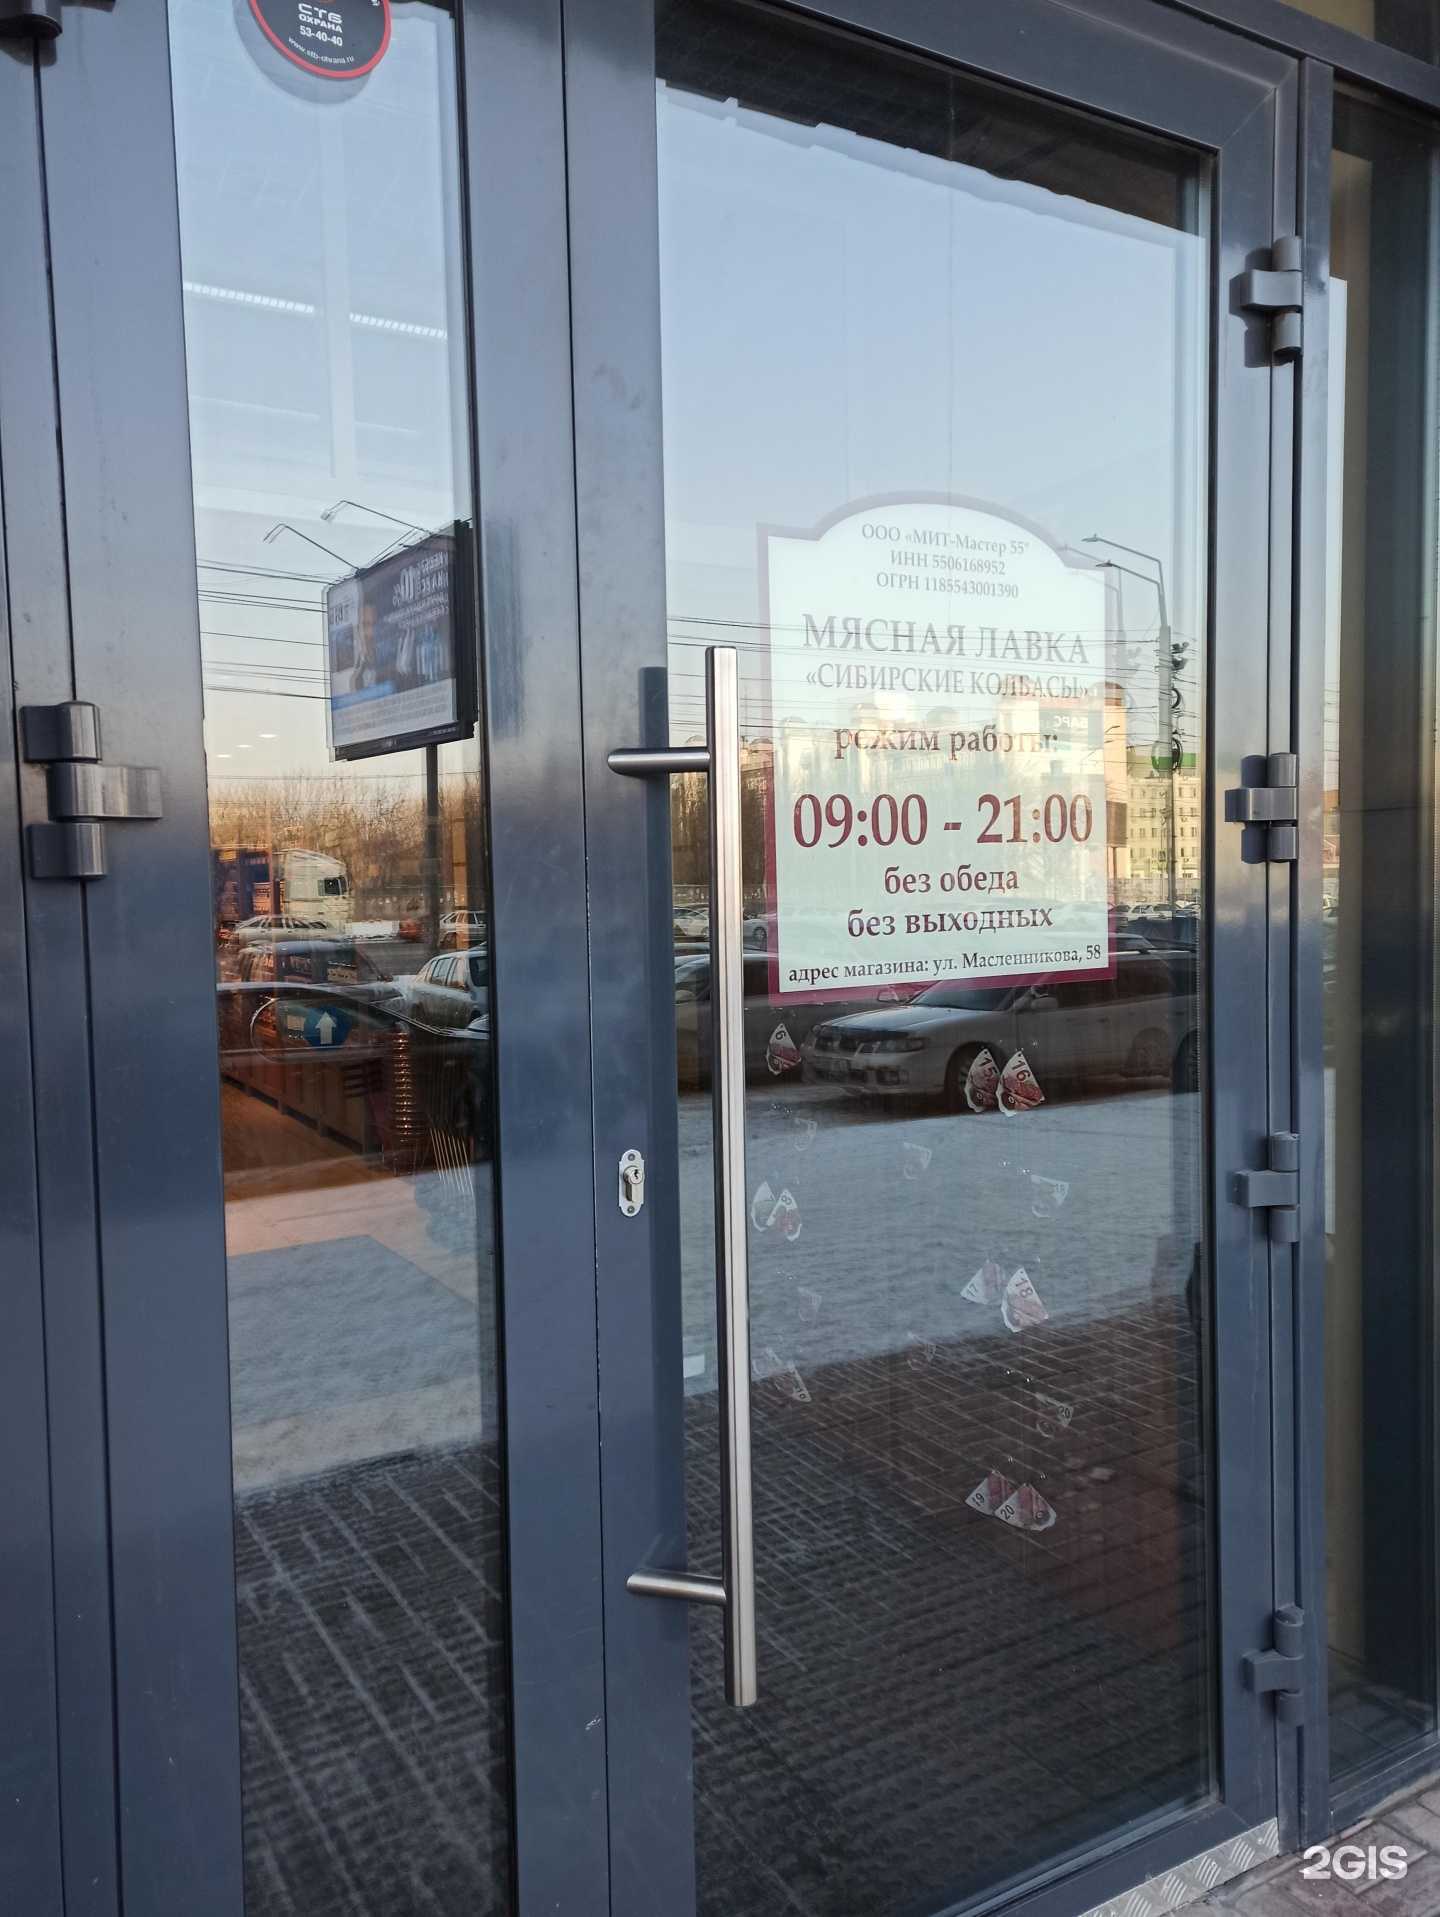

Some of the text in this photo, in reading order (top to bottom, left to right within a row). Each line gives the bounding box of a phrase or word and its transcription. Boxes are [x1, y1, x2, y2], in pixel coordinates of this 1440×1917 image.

[299, 13, 343, 33] ОХРАНА
[300, 25, 343, 47] 53-40-40
[861, 523, 901, 542] ООО
[890, 549, 1006, 576] ИНН 5506168952
[876, 572, 1019, 599] ОГРН 1185543001390
[802, 613, 1089, 664] МЯСНАЯ ЛАВКА
[806, 663, 1089, 699] «СИБИРСКИЕ КОЛБАСЫ»
[793, 793, 928, 849] 09:00
[976, 793, 1093, 844] 21:00
[884, 864, 1019, 894] без обеда
[847, 907, 1053, 937] без выходных
[788, 944, 1101, 984] адрес магазина: ул. Масленникова, 58
